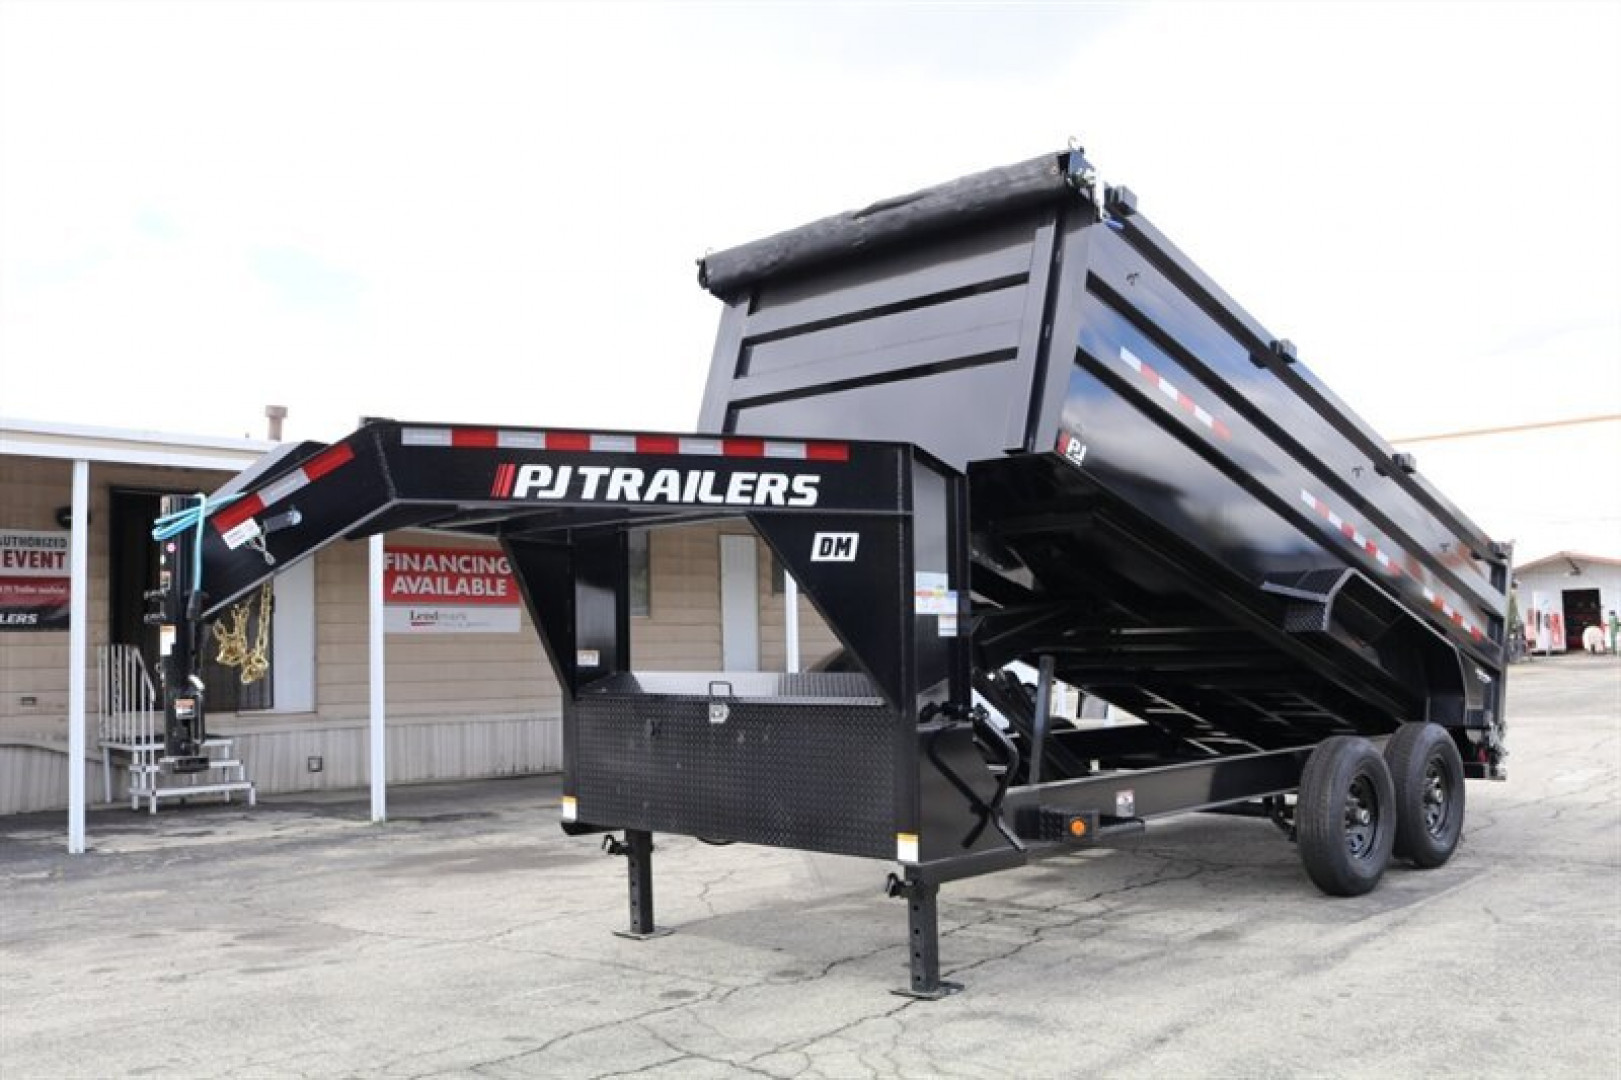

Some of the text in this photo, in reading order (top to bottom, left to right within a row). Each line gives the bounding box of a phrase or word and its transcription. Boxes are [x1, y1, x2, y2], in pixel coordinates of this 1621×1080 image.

[512, 463, 820, 507] PJ TRAILERS
[818, 536, 853, 558] DM
[3, 549, 66, 569] EVENT
[384, 552, 512, 574] FINANCING
[391, 575, 508, 597] AVAILABLE
